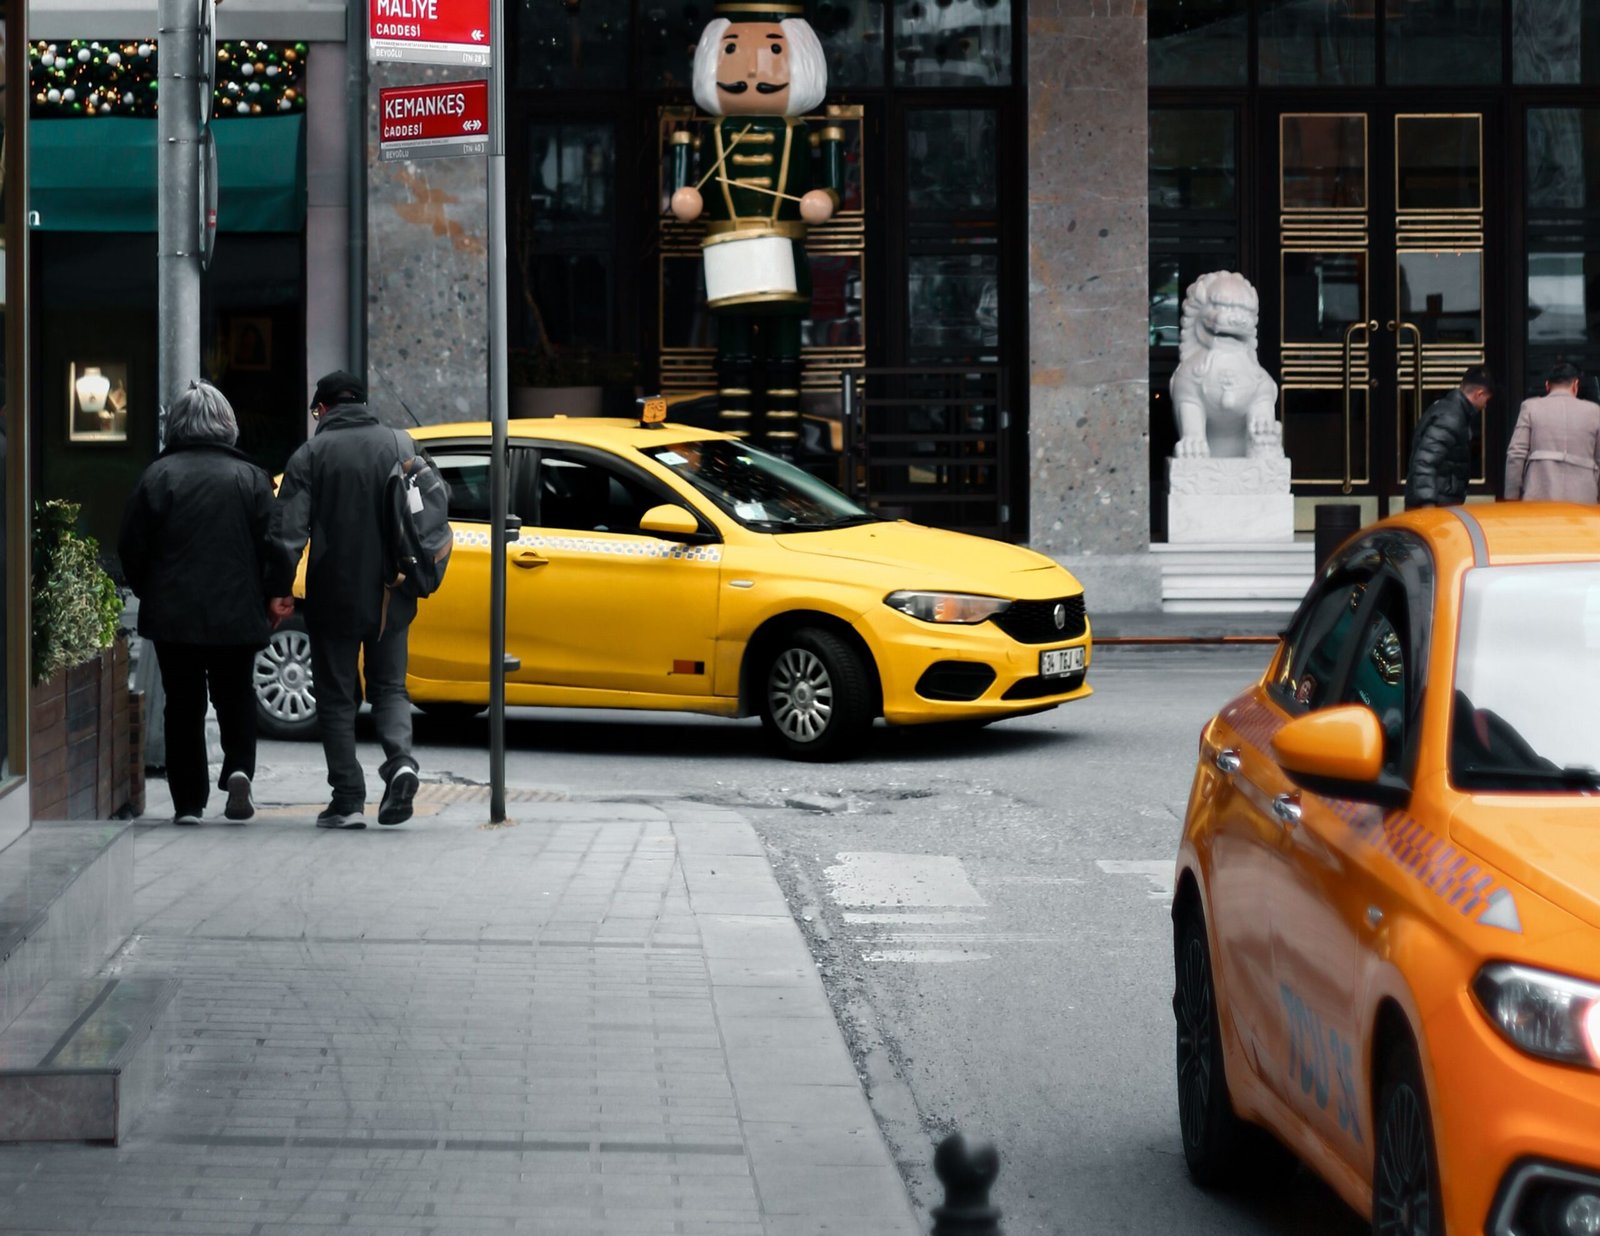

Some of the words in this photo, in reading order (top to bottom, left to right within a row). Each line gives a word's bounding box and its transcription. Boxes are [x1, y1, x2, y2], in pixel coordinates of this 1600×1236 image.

[376, 23, 420, 37] CADDESİ
[385, 93, 465, 118] KEMANKEŞ
[384, 122, 422, 138] CADDESİ
